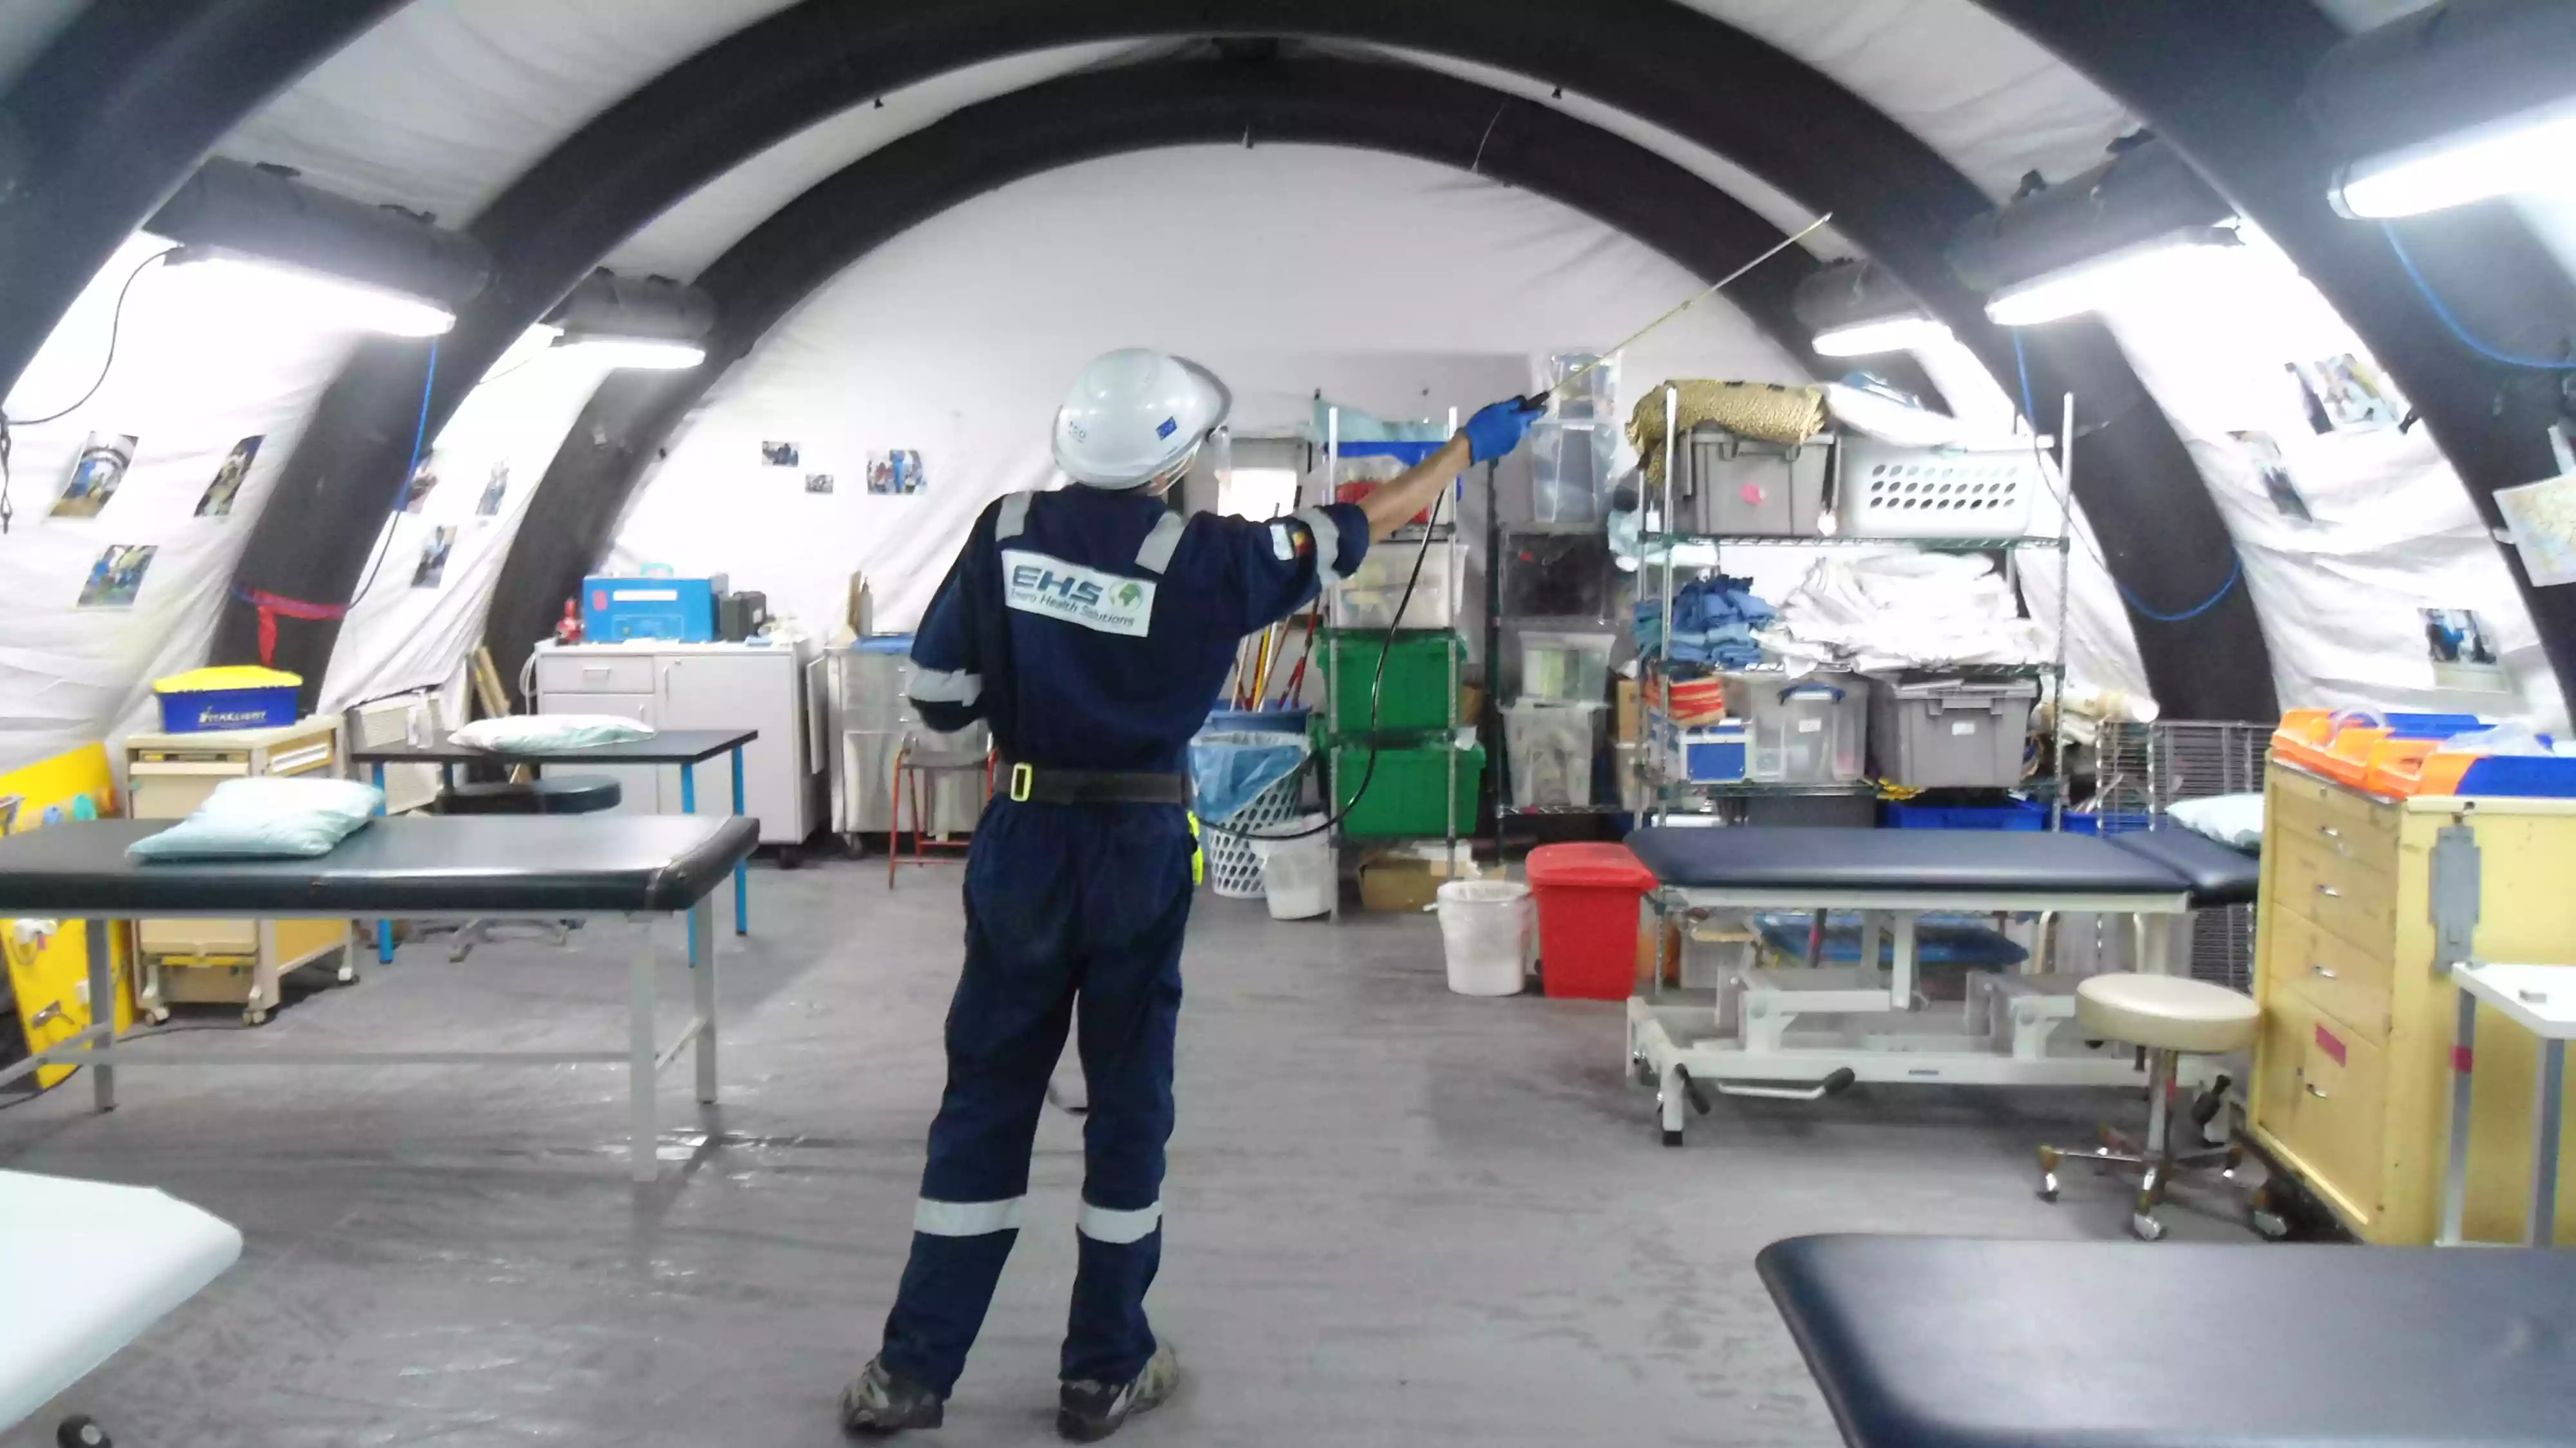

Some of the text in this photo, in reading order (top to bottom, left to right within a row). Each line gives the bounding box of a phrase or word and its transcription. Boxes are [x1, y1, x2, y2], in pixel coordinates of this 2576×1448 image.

[1013, 565, 1103, 605] EHS
[1039, 594, 1079, 613] Health
[1079, 605, 1135, 627] Solutions
